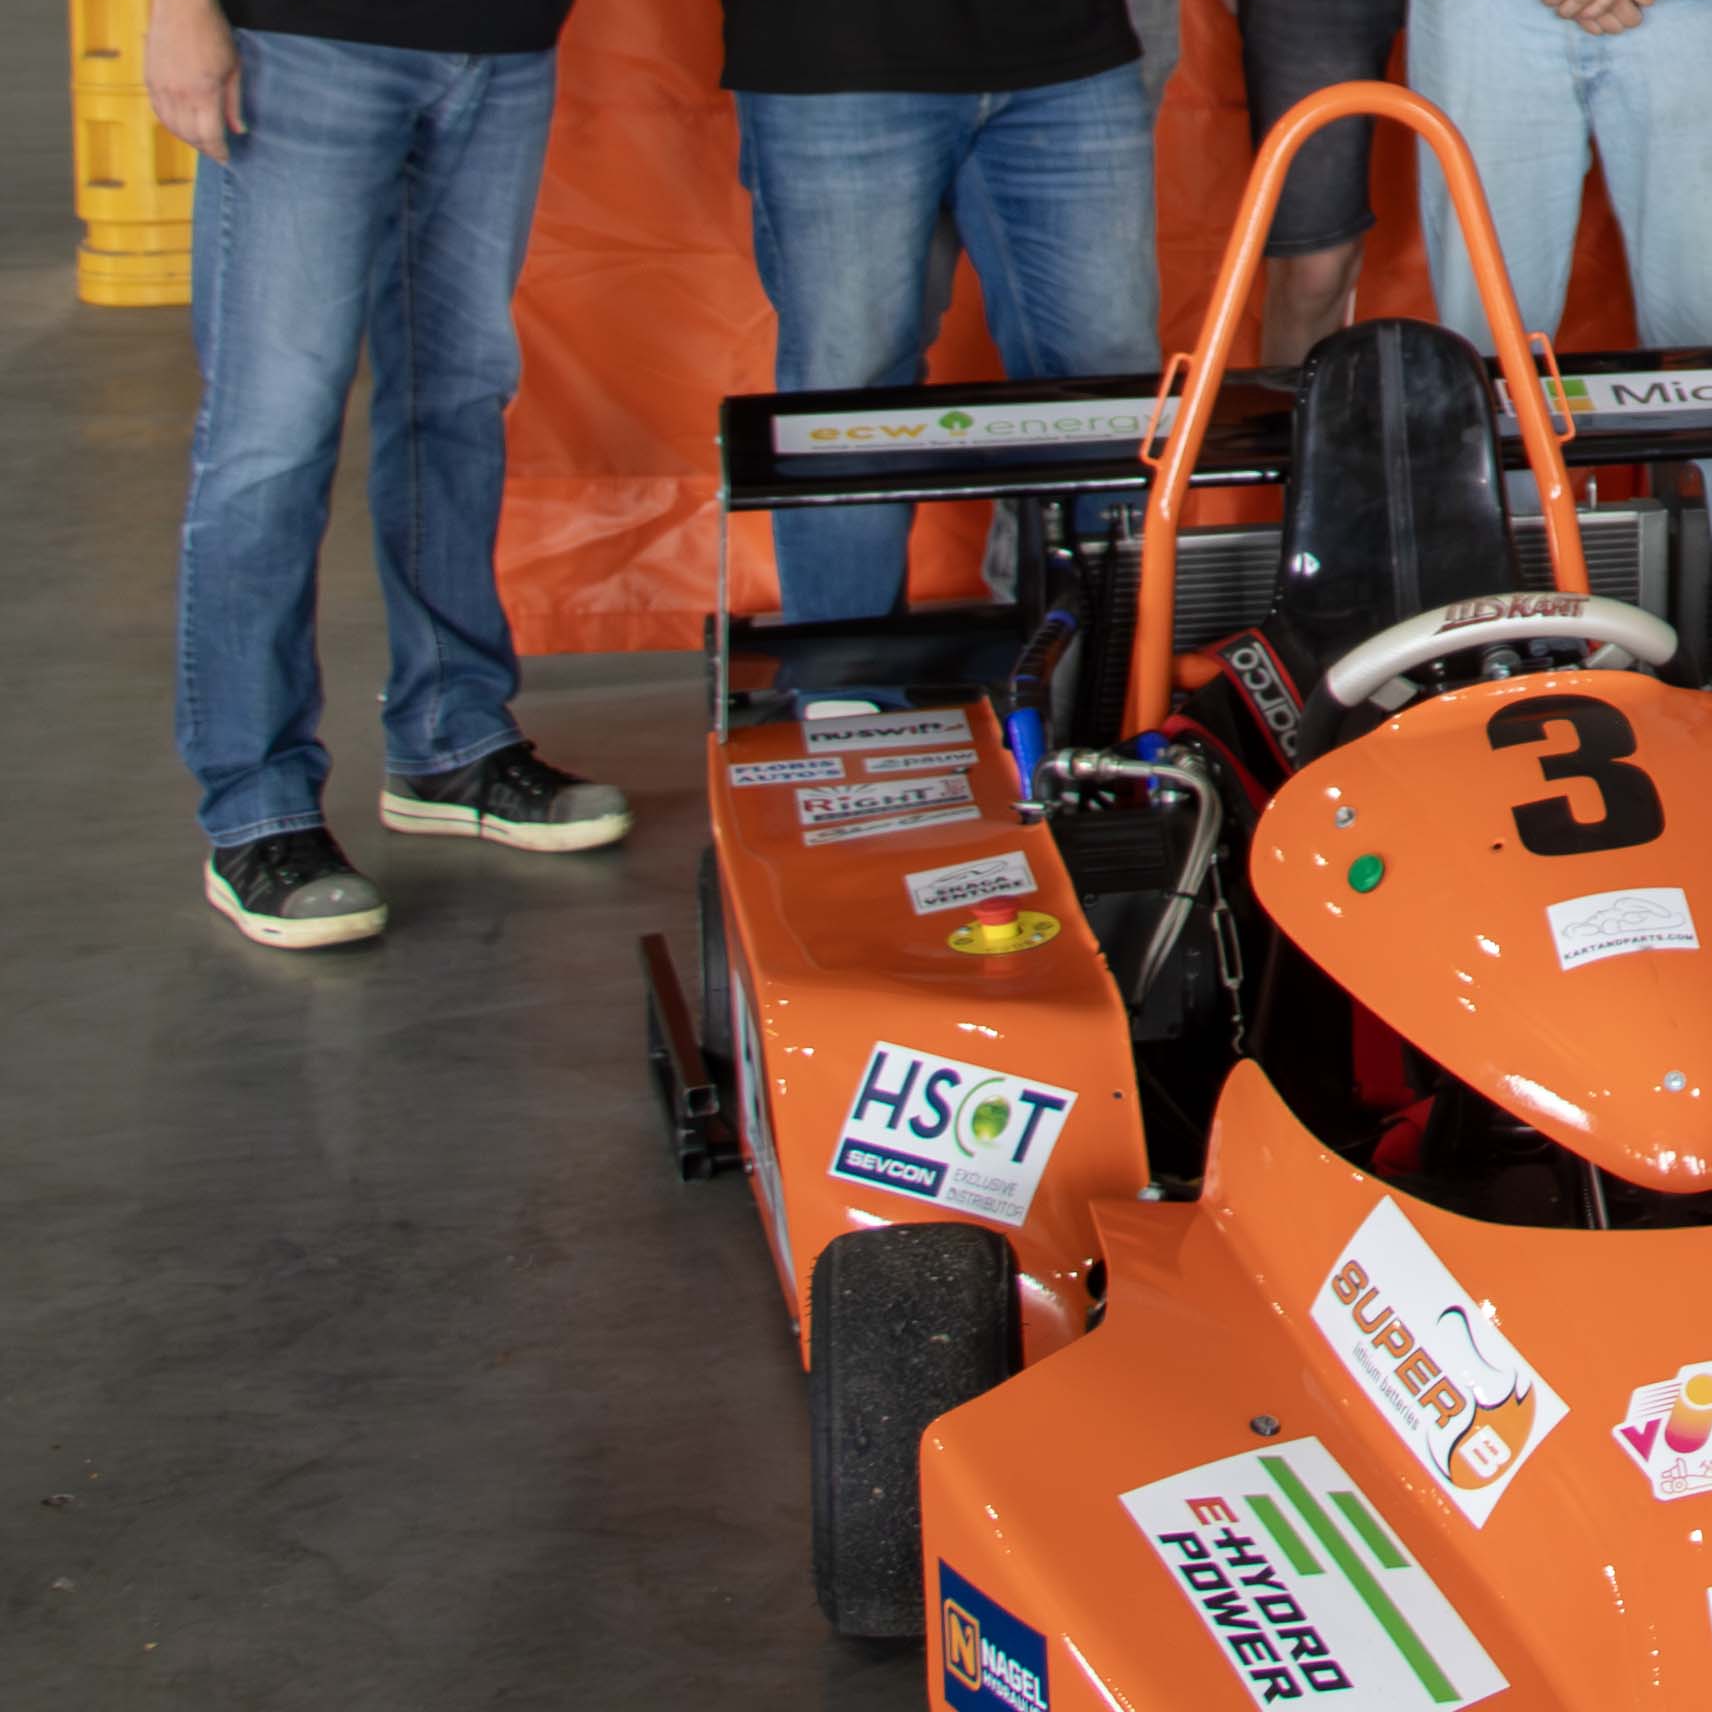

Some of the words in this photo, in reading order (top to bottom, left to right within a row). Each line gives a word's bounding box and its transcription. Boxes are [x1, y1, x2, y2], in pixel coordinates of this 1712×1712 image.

[809, 423, 927, 443] ecw
[735, 759, 835, 774] FLORIS
[737, 770, 841, 783] AUTO'S
[1486, 694, 1665, 857] 3
[924, 880, 1024, 906] VENTURE
[845, 1150, 937, 1186] SEVCON
[953, 1168, 1018, 1197] EXCLUSIVE
[945, 1187, 1024, 1219] DISTRIBUTOR
[1331, 1259, 1467, 1428] SUPER
[1458, 1424, 1512, 1479] B
[1352, 1341, 1383, 1384] lithium
[1378, 1376, 1419, 1432] batteries
[1156, 1530, 1303, 1706] POWER
[981, 1638, 1048, 1710] NAGEL
